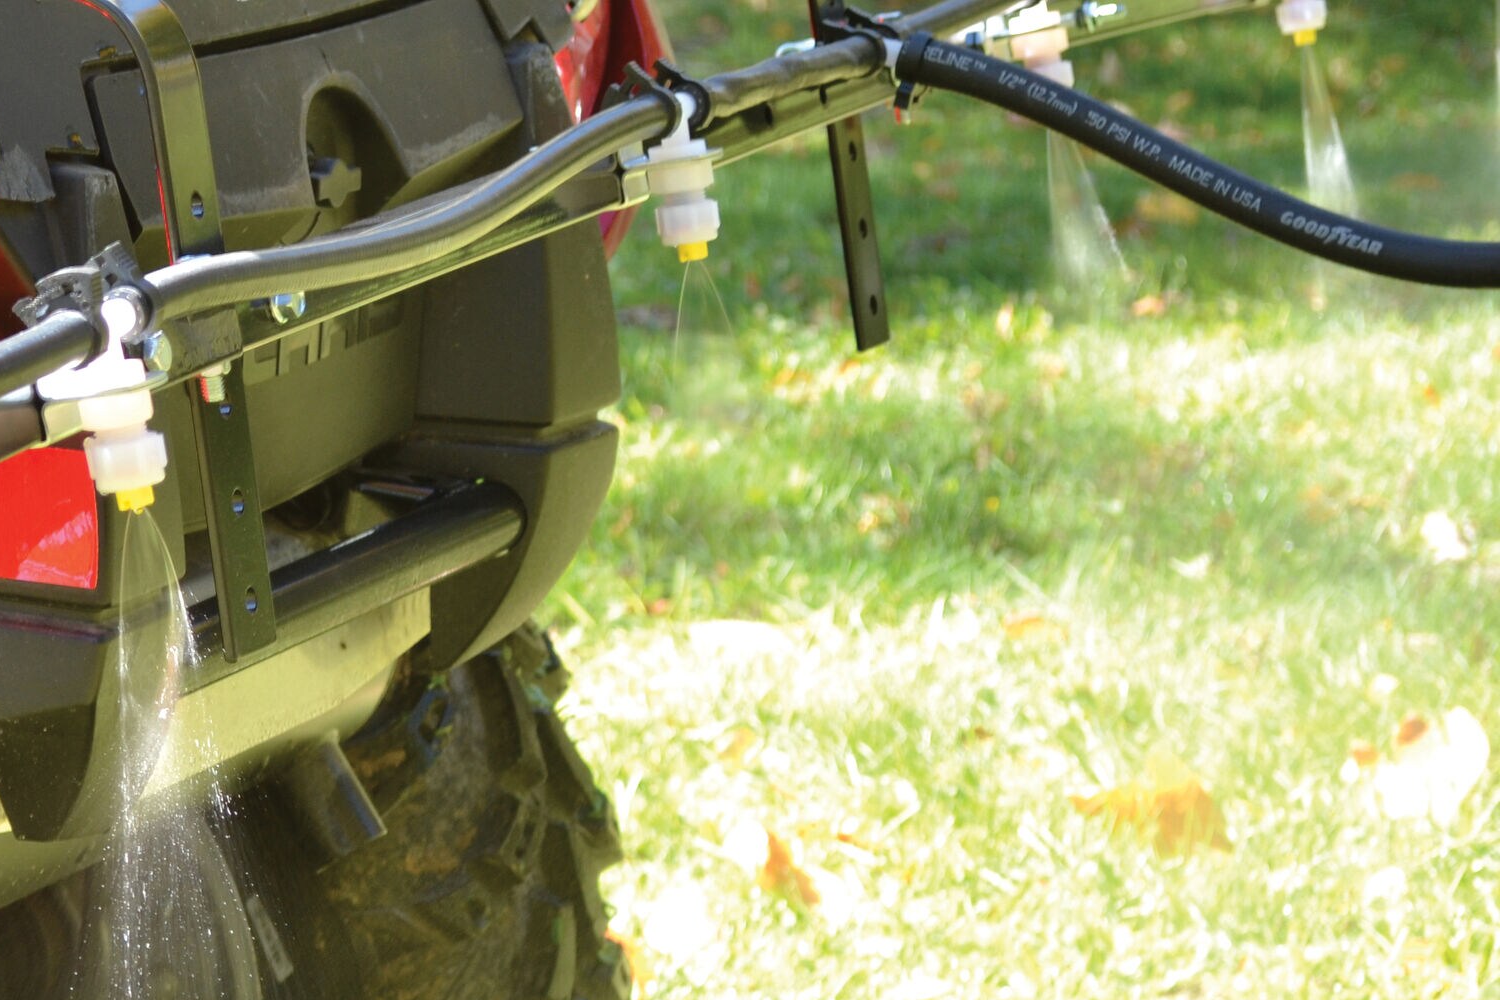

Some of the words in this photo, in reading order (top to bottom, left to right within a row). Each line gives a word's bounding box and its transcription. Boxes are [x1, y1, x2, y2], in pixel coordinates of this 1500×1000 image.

[1107, 122, 1132, 144] PSI
[1168, 155, 1214, 187] MADE
[1213, 178, 1232, 197] IN
[1232, 186, 1263, 213] USA
[1280, 210, 1384, 256] GOODYEAR
